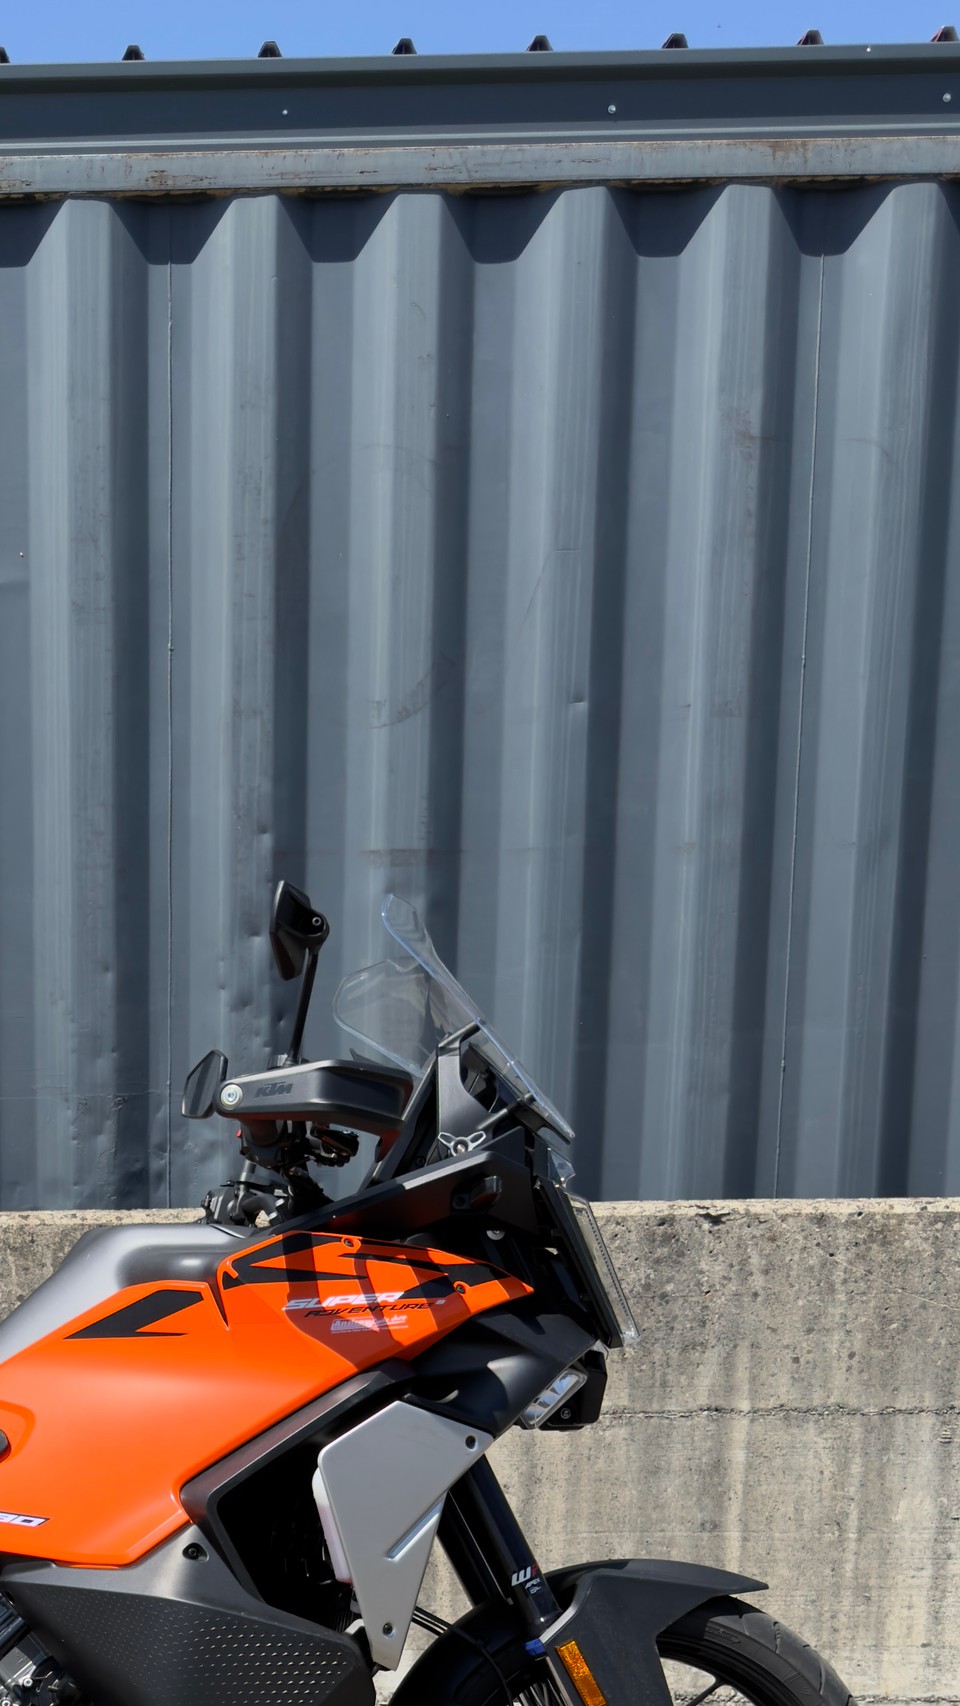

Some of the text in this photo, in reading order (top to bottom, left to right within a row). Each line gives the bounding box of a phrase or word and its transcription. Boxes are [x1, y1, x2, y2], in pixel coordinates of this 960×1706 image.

[254, 1081, 293, 1098] KTM
[282, 1291, 405, 1311] SUPER
[305, 1302, 434, 1317] ADVENTURE
